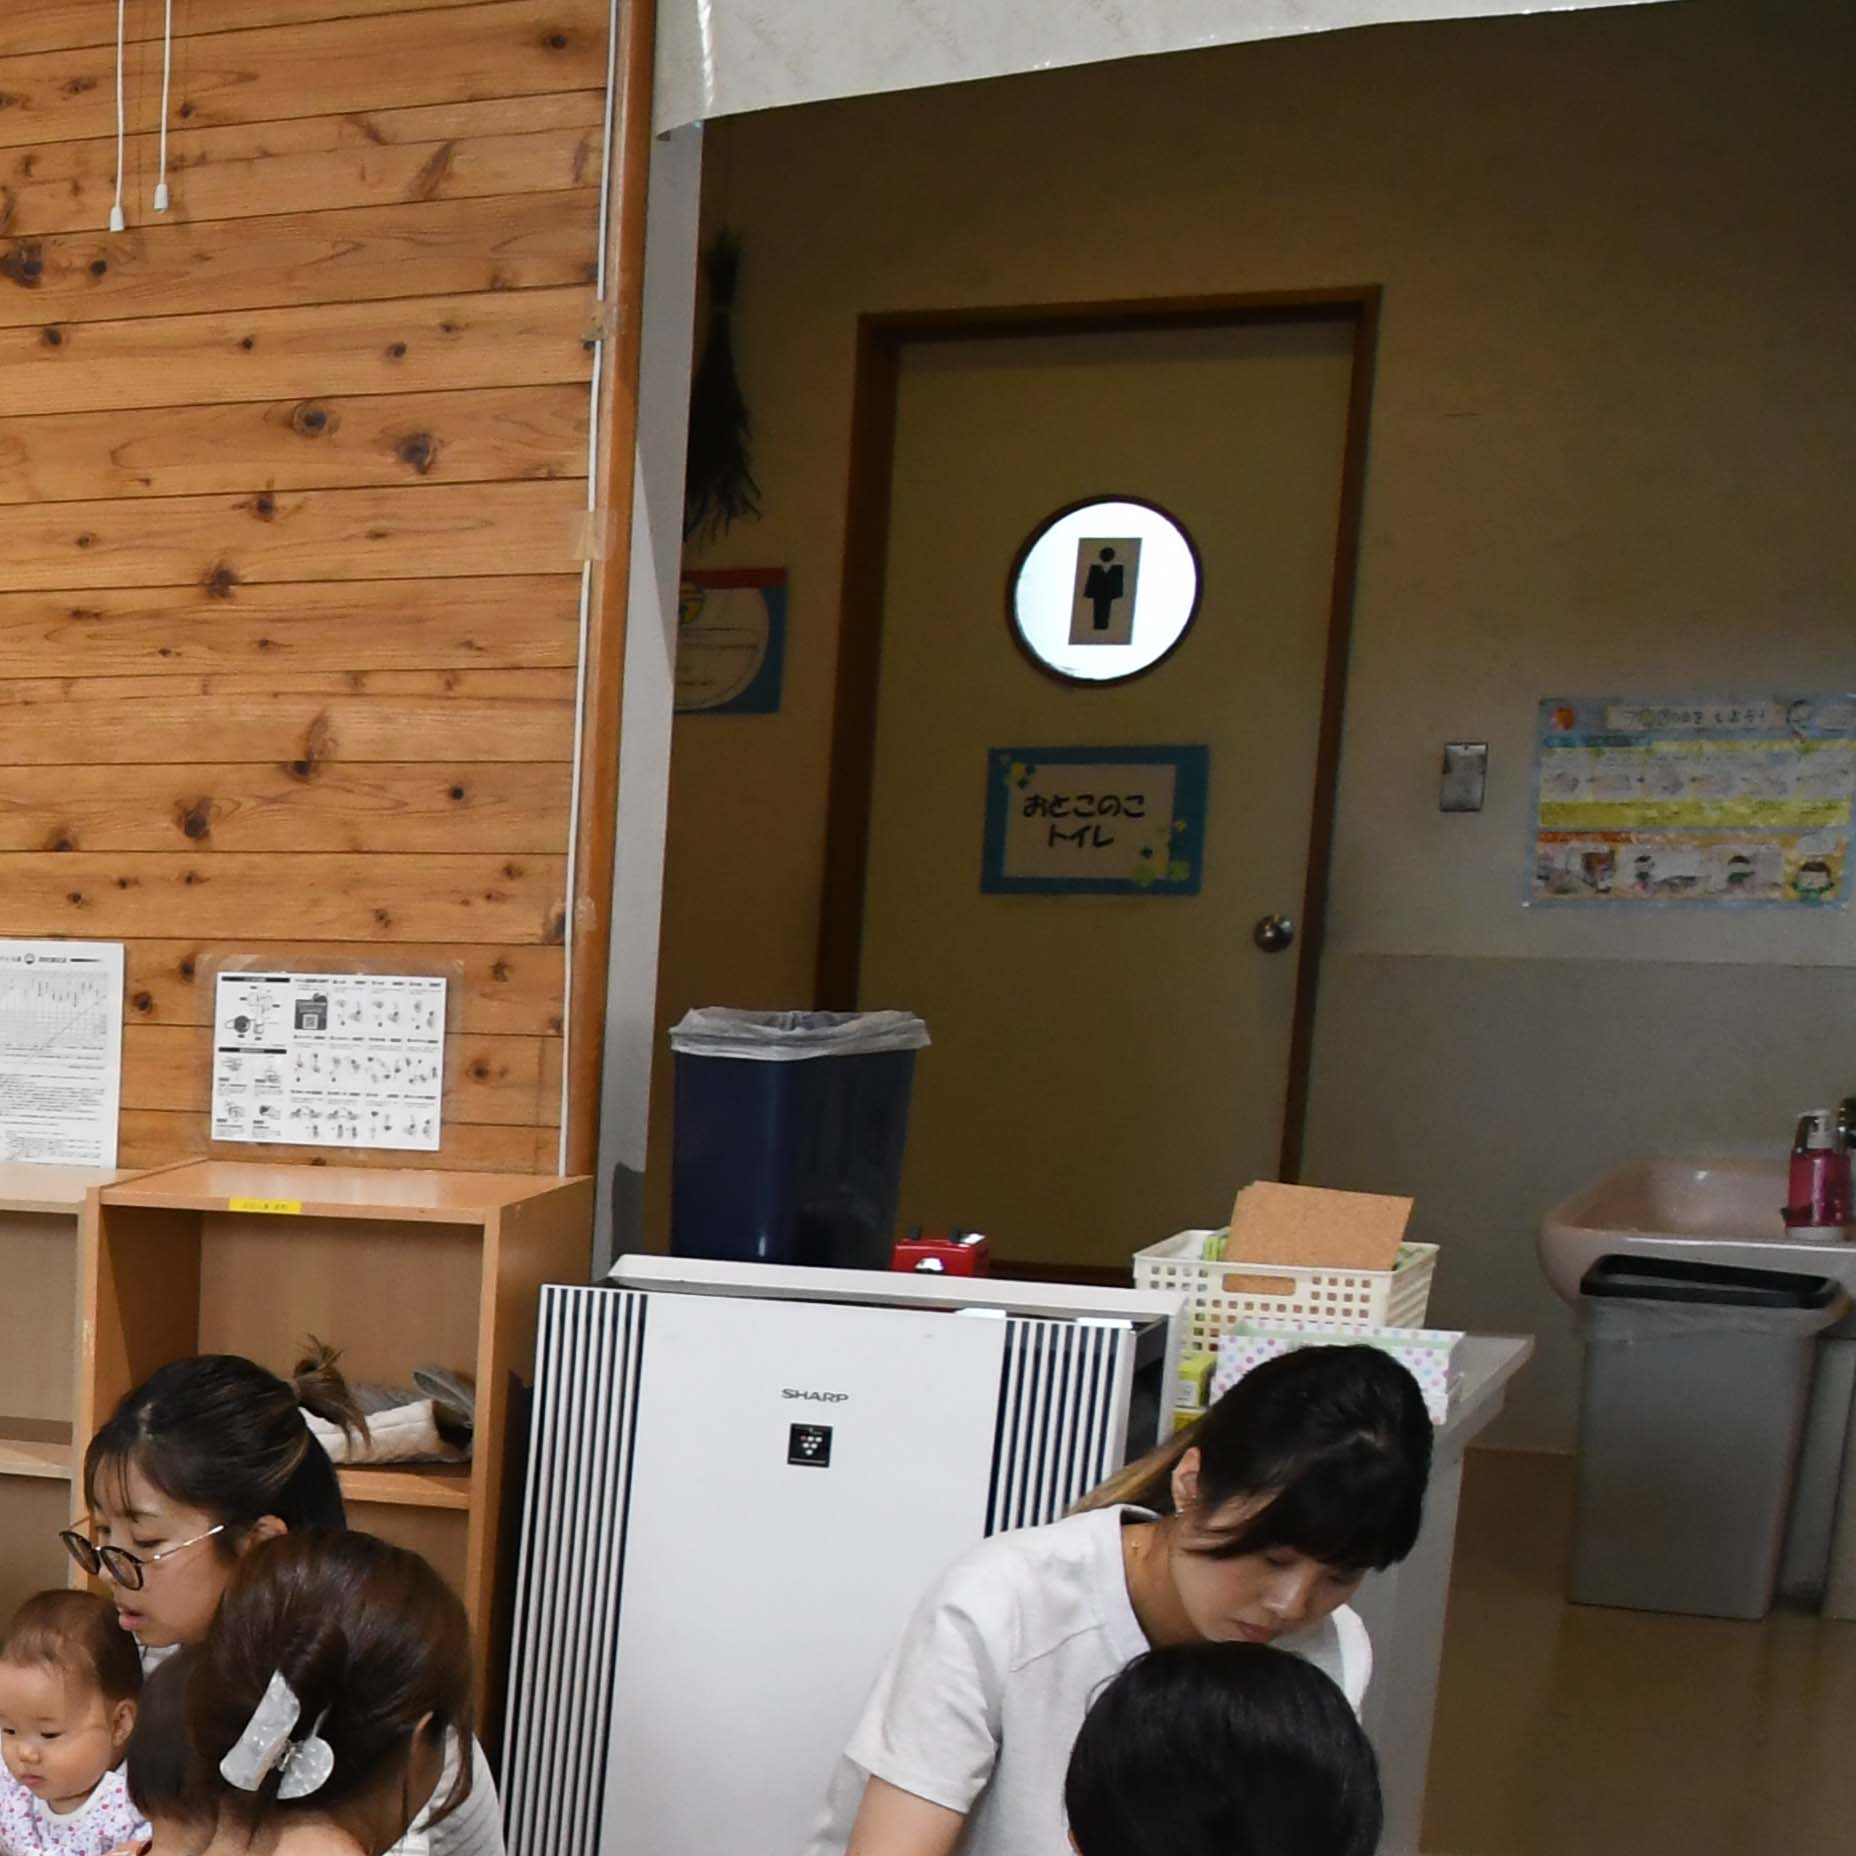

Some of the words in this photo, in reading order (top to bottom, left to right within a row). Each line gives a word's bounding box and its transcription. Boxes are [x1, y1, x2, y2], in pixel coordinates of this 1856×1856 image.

[1023, 794, 1145, 818] おとこのこ
[1048, 824, 1114, 848] トイレ
[781, 1388, 849, 1403] SHARP
